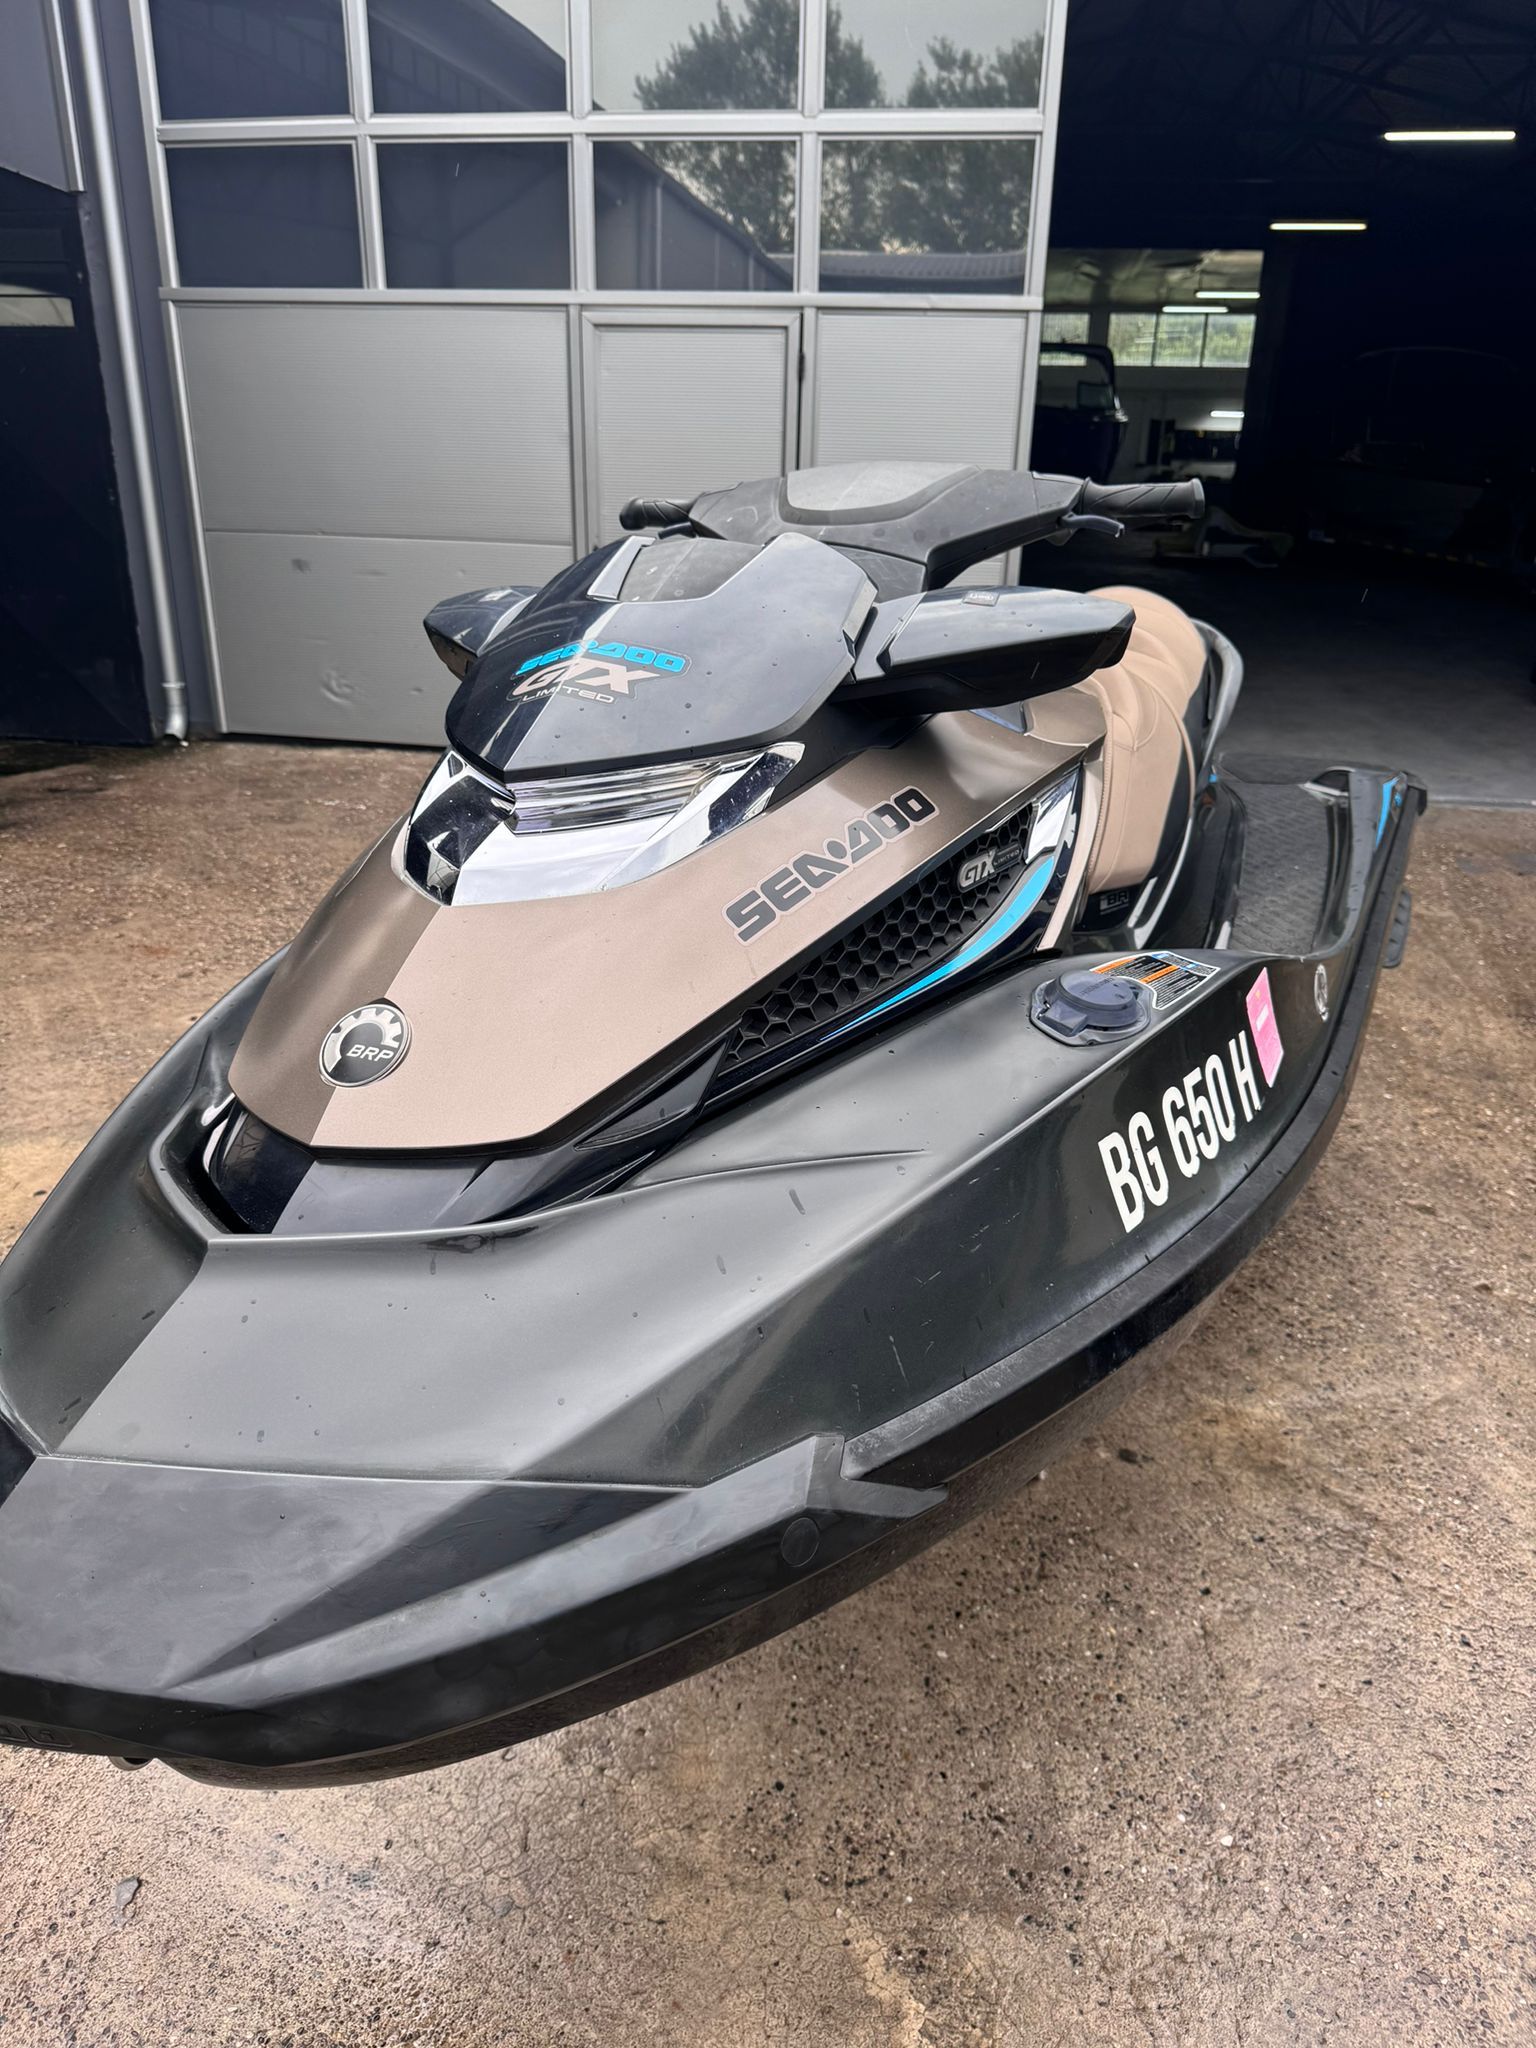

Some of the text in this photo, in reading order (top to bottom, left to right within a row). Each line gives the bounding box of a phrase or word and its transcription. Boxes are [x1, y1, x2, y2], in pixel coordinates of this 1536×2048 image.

[512, 658, 660, 695] GTX
[523, 685, 615, 703] LIMITED
[960, 848, 997, 888] GTX
[346, 1044, 395, 1062] BRP
[1098, 1030, 1262, 1233] BG 650 H
